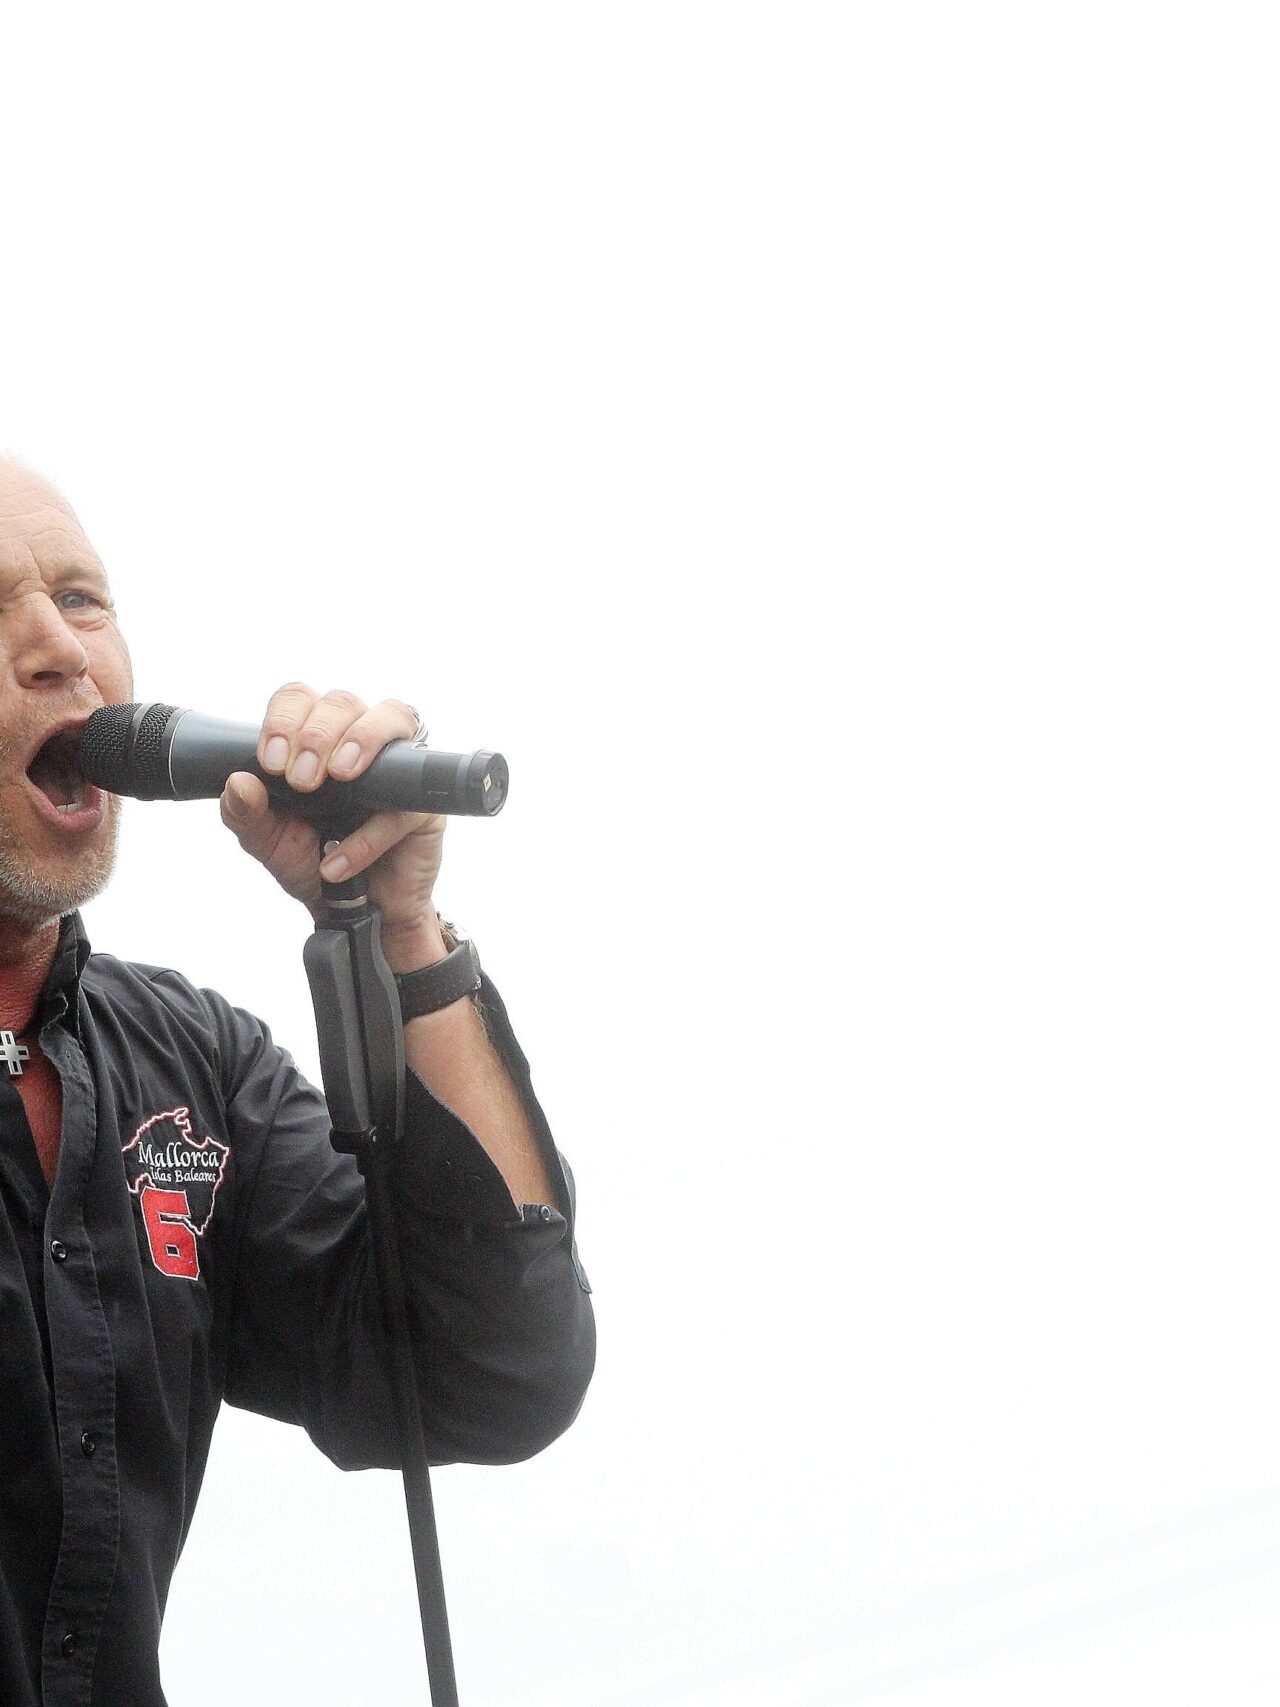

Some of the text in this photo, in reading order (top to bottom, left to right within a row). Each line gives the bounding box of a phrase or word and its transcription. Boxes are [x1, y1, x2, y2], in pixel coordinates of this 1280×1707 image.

[138, 1141, 220, 1168] Mallorca
[150, 1166, 217, 1183] Islas Baleares
[140, 1186, 200, 1281] 6
